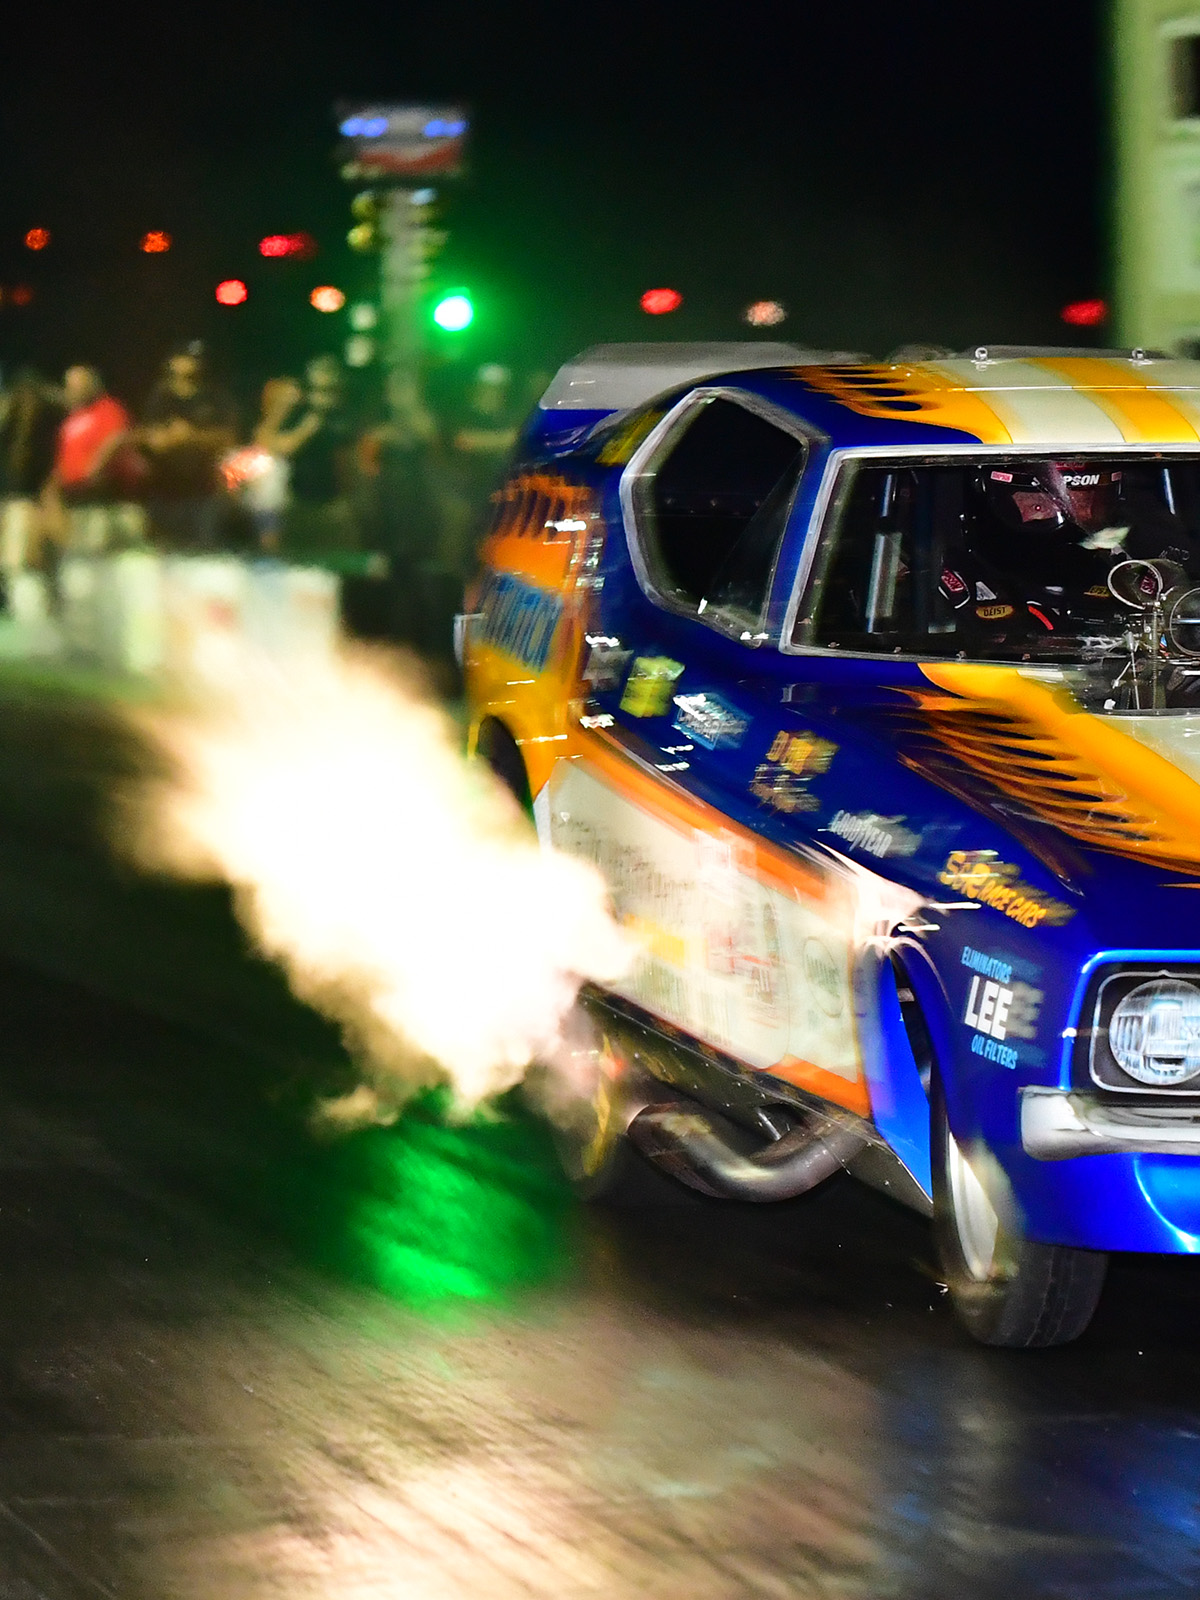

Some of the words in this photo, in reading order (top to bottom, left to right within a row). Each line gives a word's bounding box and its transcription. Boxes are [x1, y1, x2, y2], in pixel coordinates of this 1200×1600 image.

[983, 606, 1007, 618] DEIST
[829, 809, 892, 858] GOODYEAR
[978, 880, 1017, 911] RACE
[1006, 897, 1047, 928] CARS
[965, 975, 1013, 1040] LEE
[971, 1034, 986, 1056] OIL
[984, 1039, 1018, 1070] FILTERS
